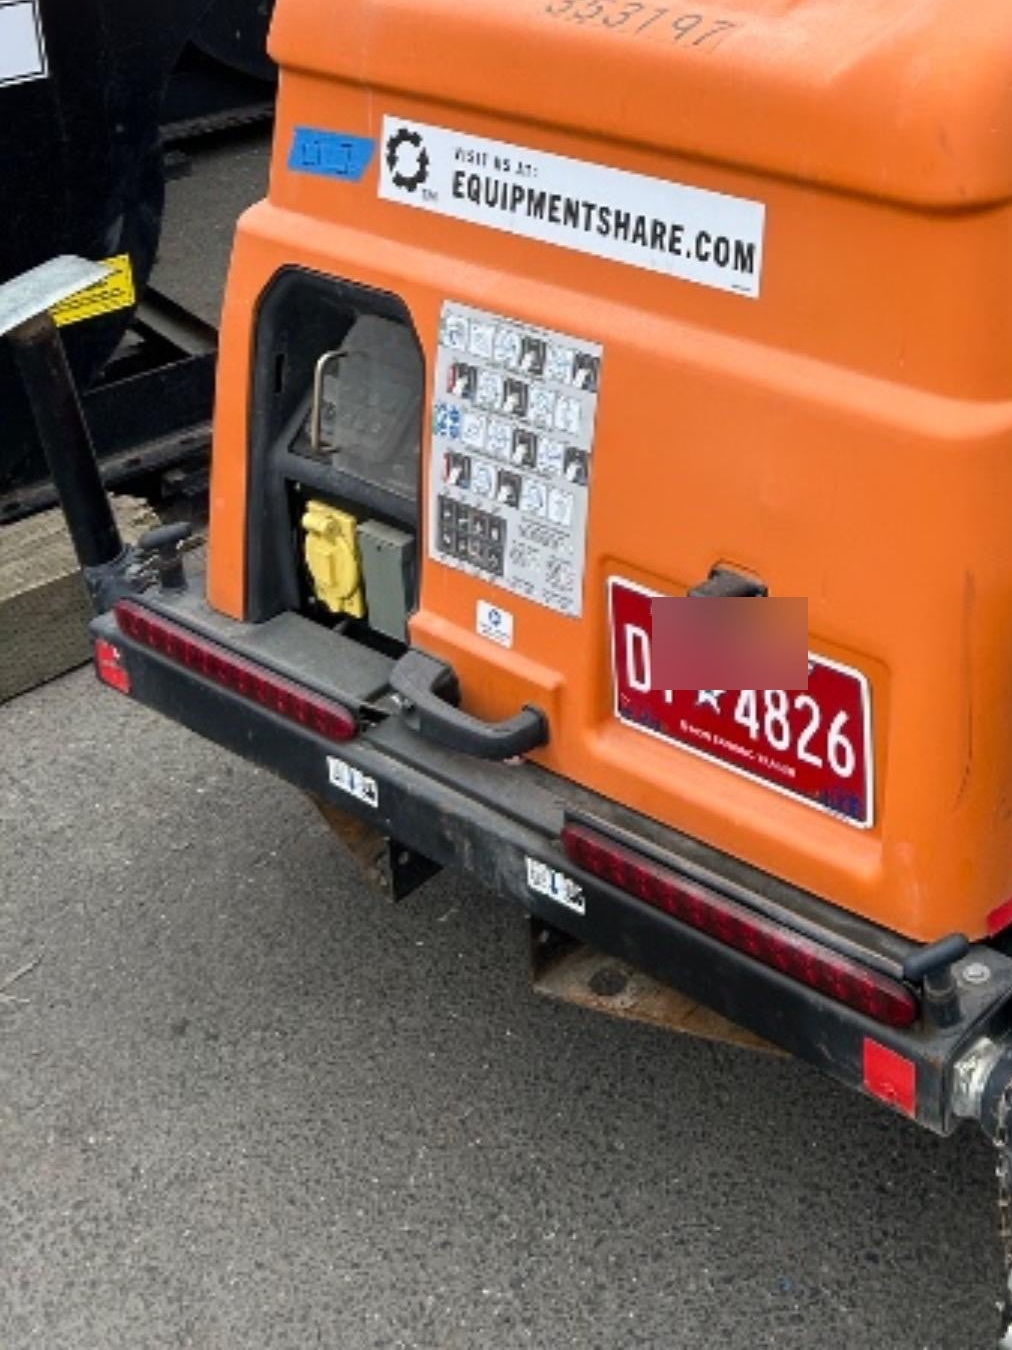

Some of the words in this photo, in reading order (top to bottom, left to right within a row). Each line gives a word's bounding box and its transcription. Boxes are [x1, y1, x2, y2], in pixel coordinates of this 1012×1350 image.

[454, 146, 488, 167] VISIT
[494, 156, 511, 172] US
[515, 161, 538, 178] AT:
[452, 170, 756, 275] EQUIPMENTSHARE.COM
[734, 690, 856, 778] 4826
